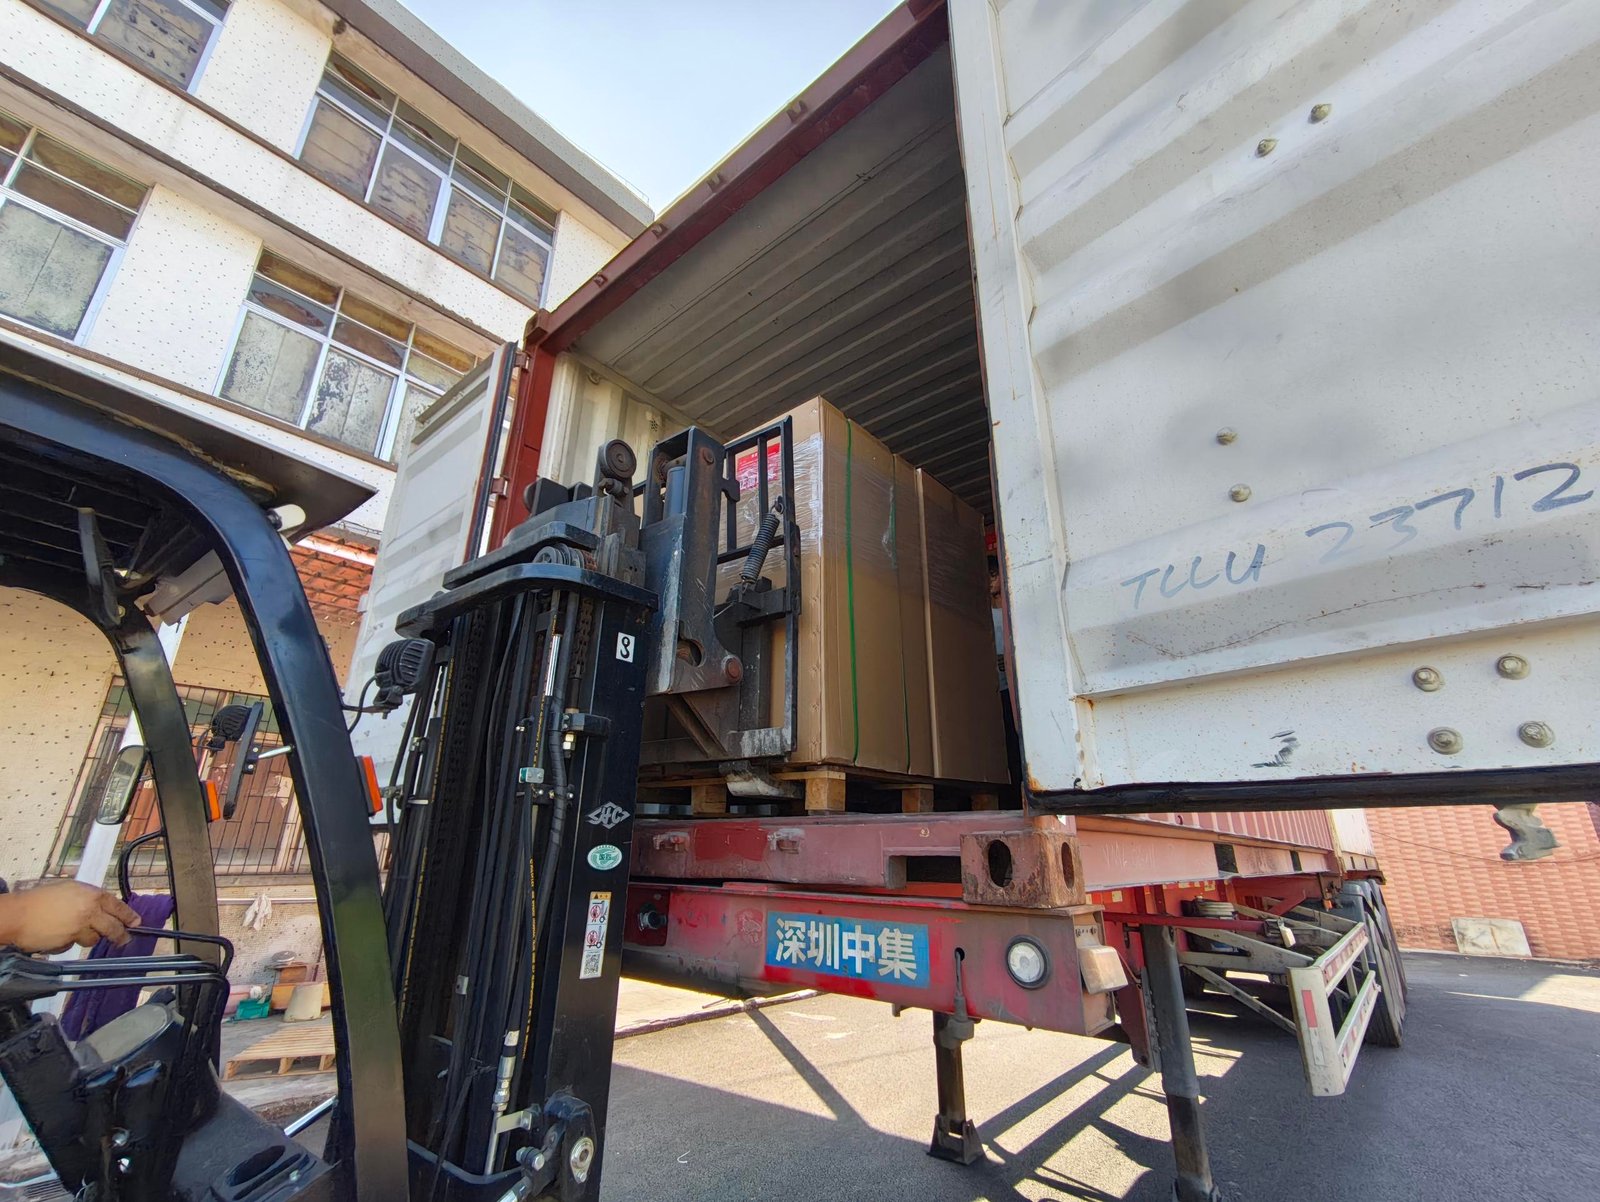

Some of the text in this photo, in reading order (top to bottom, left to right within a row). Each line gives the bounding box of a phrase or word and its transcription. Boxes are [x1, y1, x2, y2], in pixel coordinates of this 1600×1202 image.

[1306, 462, 1594, 563] 23712
[775, 917, 918, 981] 深圳中集
